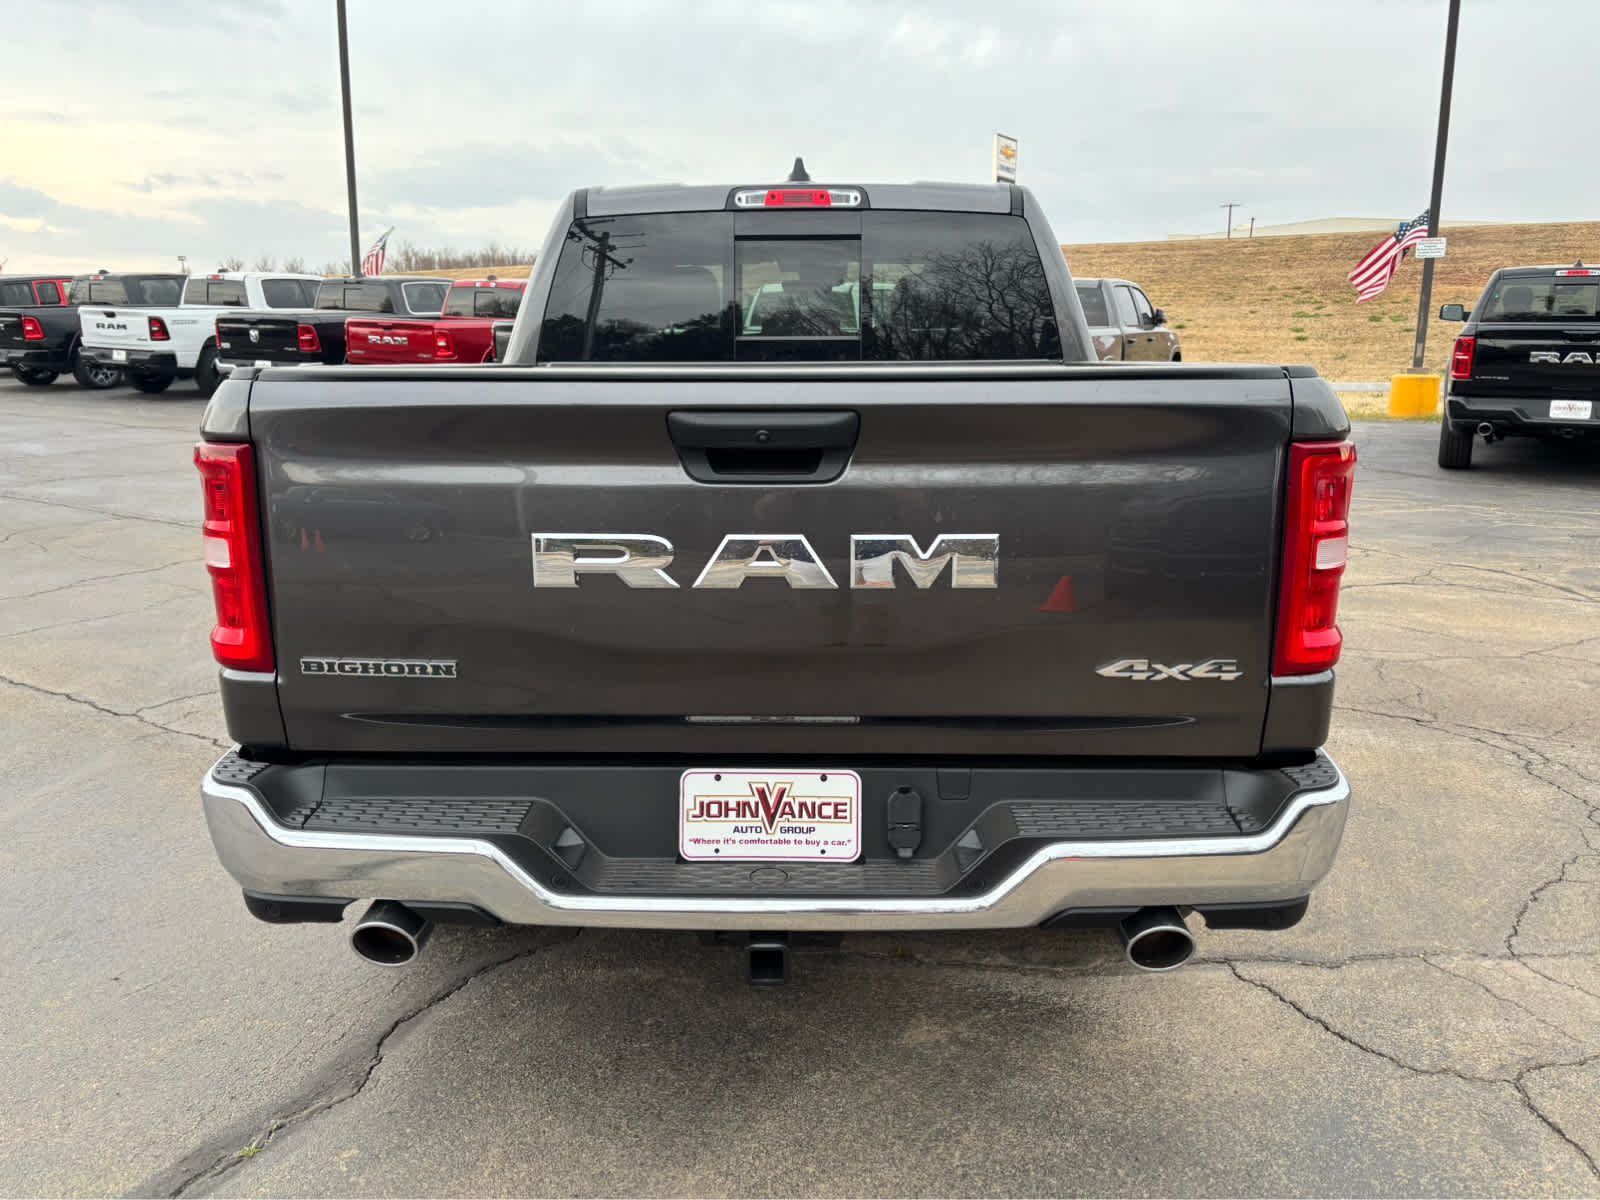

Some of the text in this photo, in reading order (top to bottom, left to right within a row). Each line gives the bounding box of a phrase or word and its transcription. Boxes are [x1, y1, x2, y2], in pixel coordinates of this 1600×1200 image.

[531, 532, 1000, 589] RAM
[300, 656, 457, 678] BIGHORN
[691, 785, 848, 831] JOHN VANCE
[733, 825, 816, 835] AUTO GROUP
[723, 837, 737, 845] it's
[738, 838, 791, 846] comfortable
[794, 838, 803, 846] to
[805, 838, 821, 848] buy
